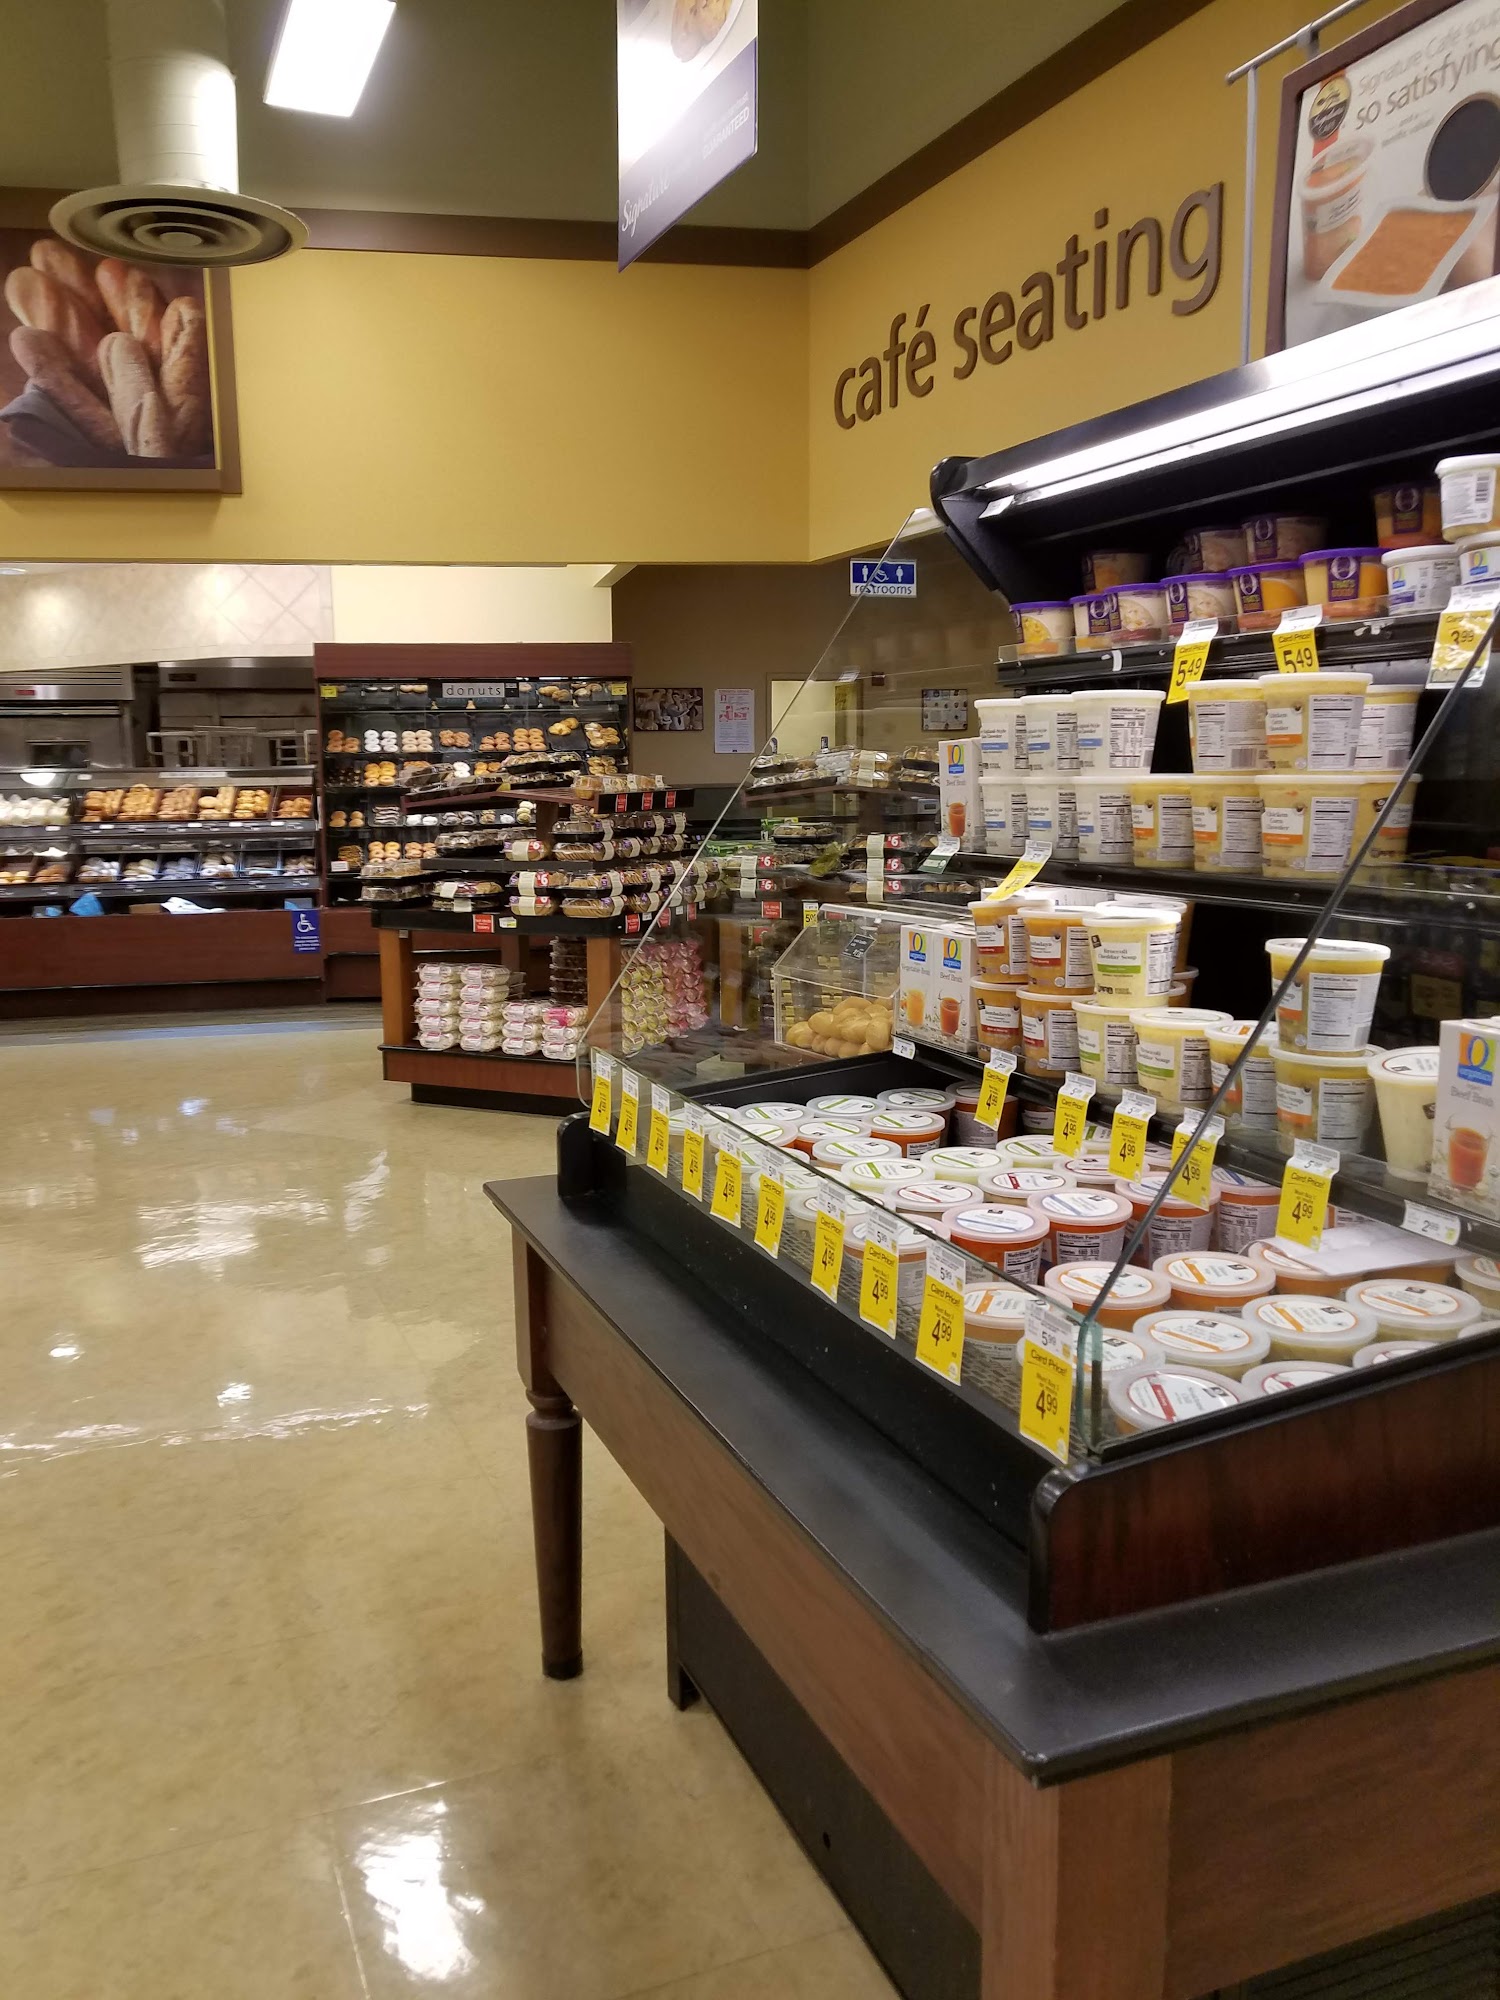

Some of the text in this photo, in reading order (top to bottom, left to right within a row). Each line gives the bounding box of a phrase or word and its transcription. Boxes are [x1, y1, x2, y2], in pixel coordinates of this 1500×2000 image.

[1355, 100, 1382, 130] so
[834, 181, 1225, 430] café seating
[446, 683, 501, 696] donuts
[1290, 1171, 1326, 1188] Card Price!
[1291, 1200, 1314, 1224] 499
[821, 1247, 835, 1271] 499
[869, 1246, 882, 1257] Card
[871, 1278, 889, 1305] 499
[930, 1283, 961, 1308] Card Price!
[931, 1318, 952, 1347] 499
[1030, 1349, 1068, 1378] Card Price!
[1035, 1388, 1058, 1421] 499
